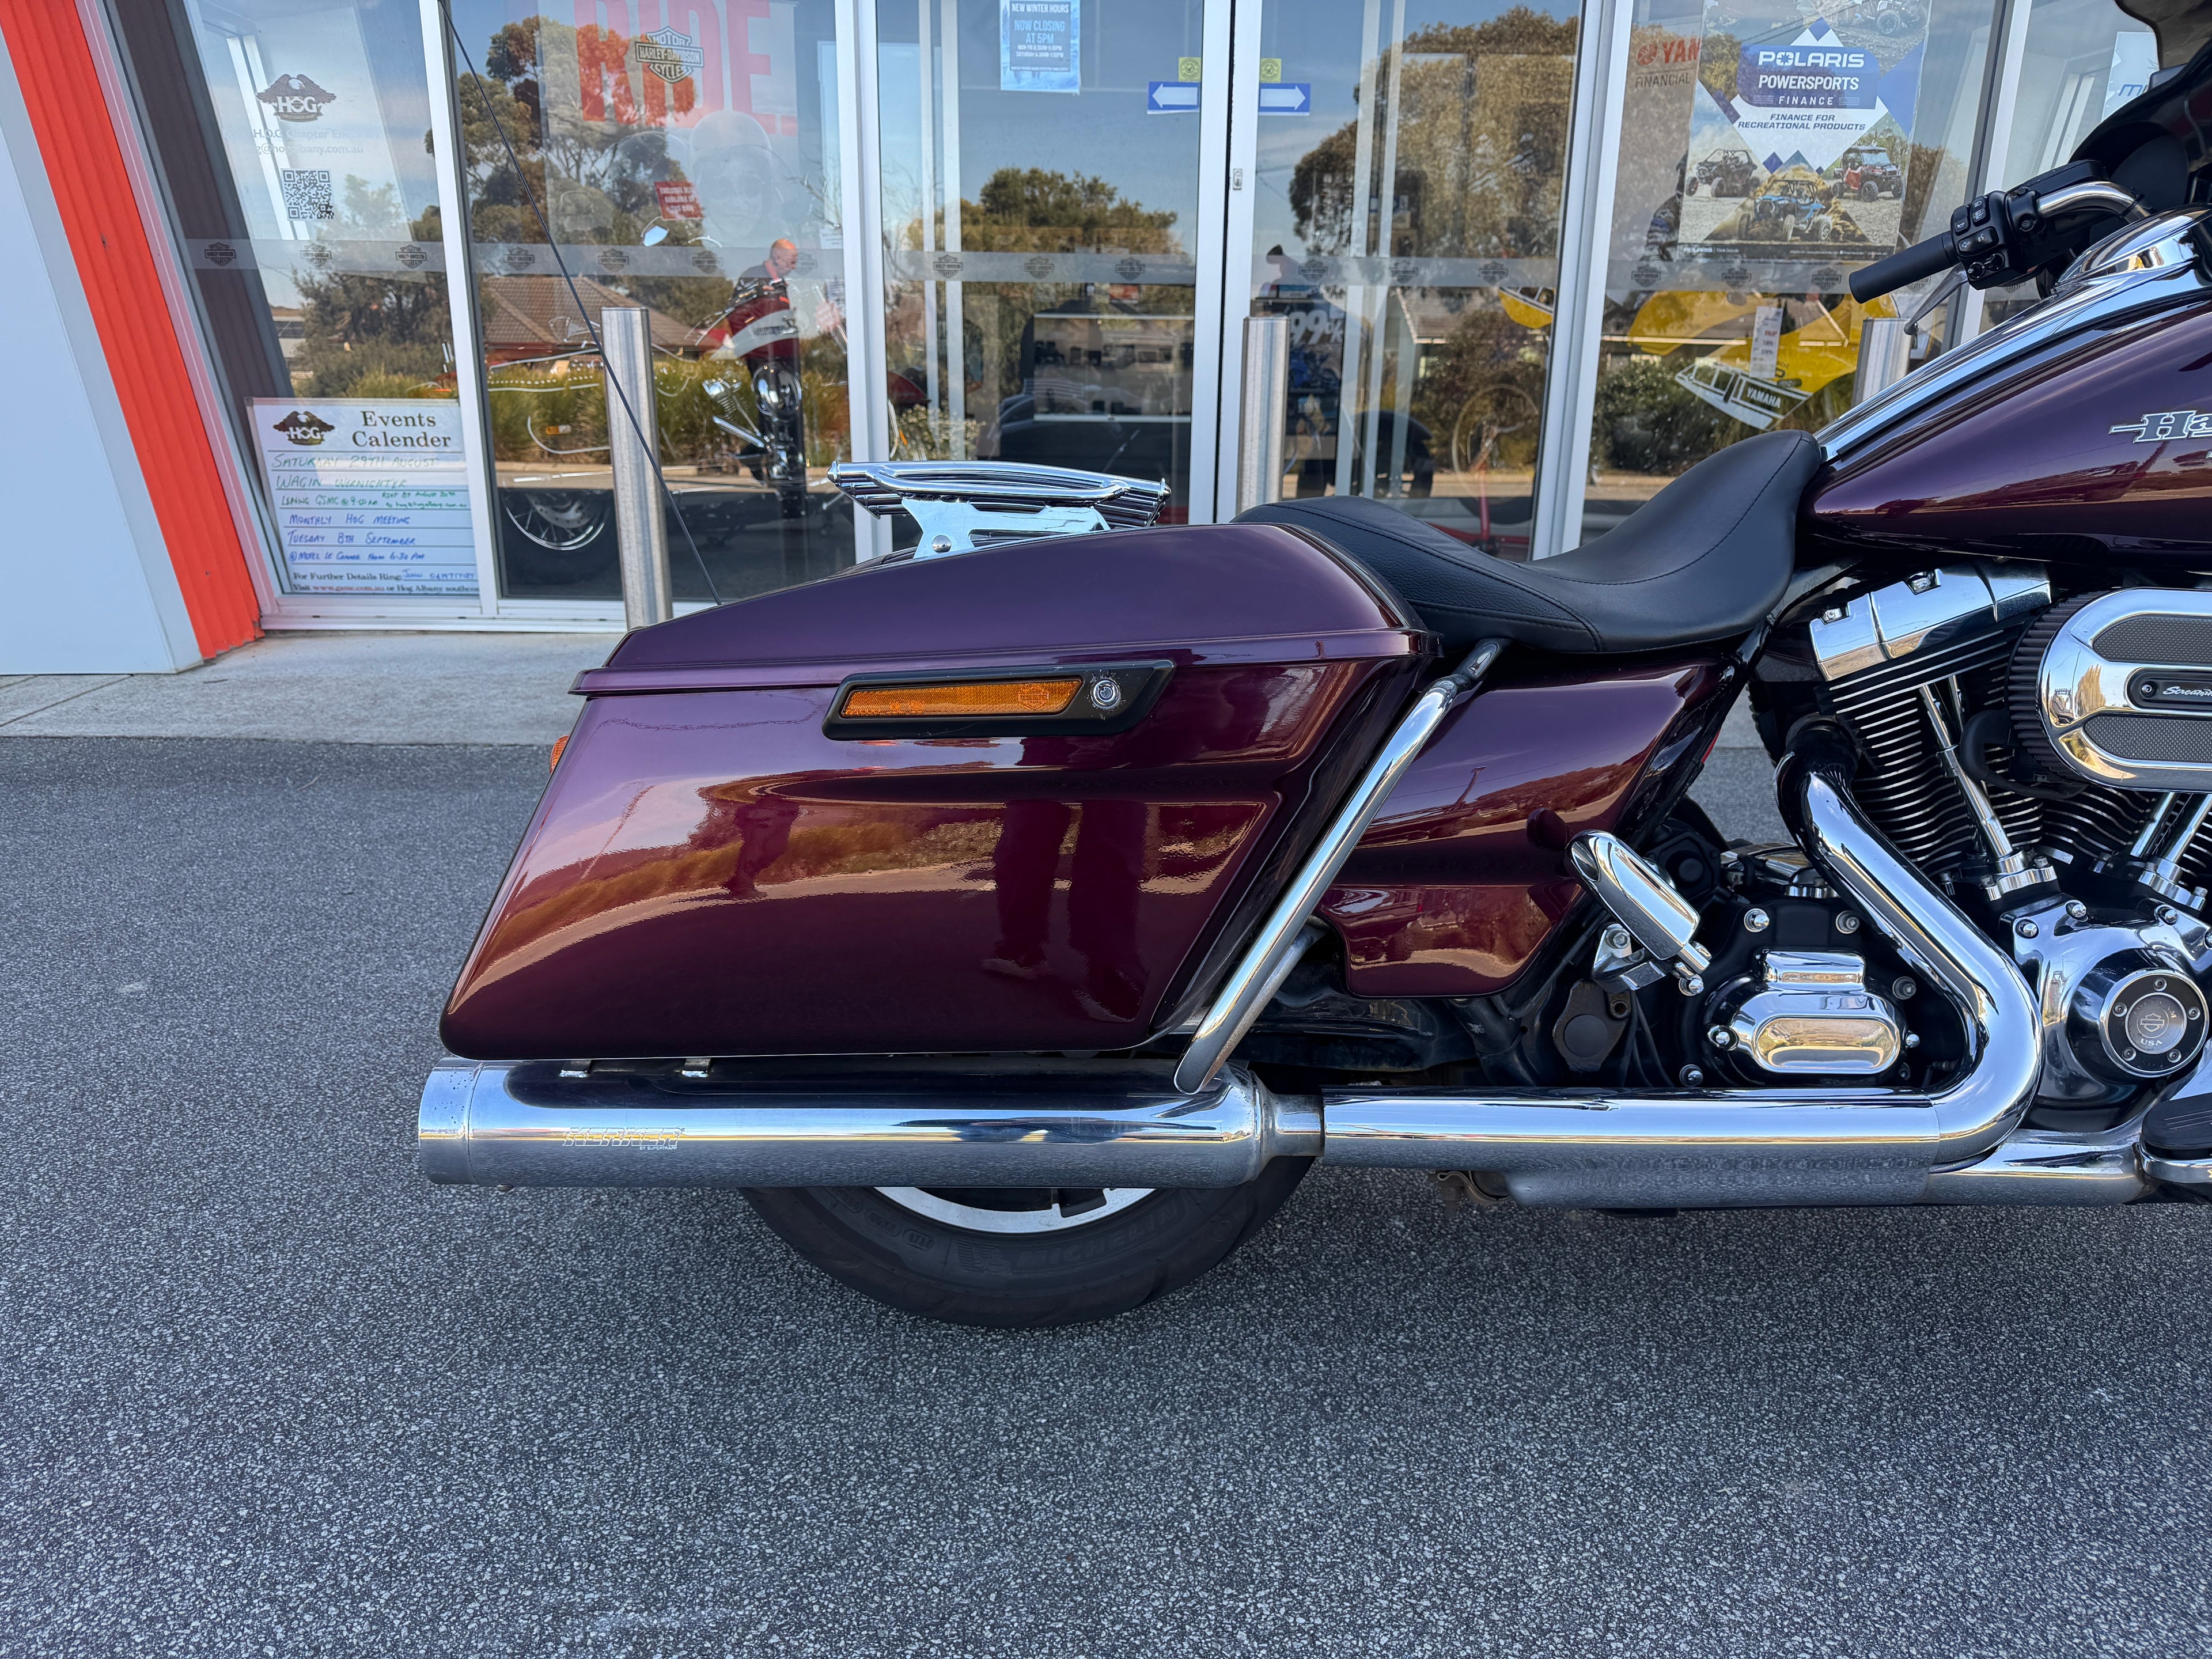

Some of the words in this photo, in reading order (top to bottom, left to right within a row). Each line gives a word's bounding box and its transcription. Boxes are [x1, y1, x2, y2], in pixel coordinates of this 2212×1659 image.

[1012, 3, 1025, 12] NEW
[1026, 3, 1048, 13] WINTER
[1050, 4, 1069, 13] HOURS
[1014, 20, 1032, 31] NOW
[1033, 20, 1065, 32] CLOSING
[1026, 33, 1036, 44] AT
[638, 46, 701, 63] HARLEY-DAVIDSON
[1758, 51, 1865, 68] POLARIS
[653, 63, 688, 79] CYCLES
[1635, 72, 1691, 89] FINANCIAL
[1758, 74, 1859, 90] POWERSPORTS
[276, 96, 317, 113] HOG
[1778, 96, 1834, 106] FINANCE
[1770, 113, 1813, 122] FINANCE
[1738, 122, 1810, 130] RECREATIONAL
[1813, 123, 1866, 131] PRODUCTS
[1746, 387, 1781, 408] YAMAHA
[289, 426, 322, 440] HOG
[360, 411, 436, 427] Events
[352, 430, 451, 447] Calender
[271, 453, 339, 468] SATURDAY
[349, 455, 384, 468] 29TH
[392, 456, 439, 468] AUGUST
[276, 475, 323, 488] WAGIN
[289, 514, 332, 525] MONTHLY
[373, 515, 410, 524] MEETING
[287, 529, 325, 544] TUESDAY
[338, 532, 354, 544] 8TH
[365, 531, 415, 544] SEPTEMBER
[293, 572, 308, 580] For
[310, 572, 344, 580] Further
[346, 573, 377, 581] Details
[2140, 1038, 2163, 1046] USA
[1016, 1198, 1179, 1267] MICHELIN
